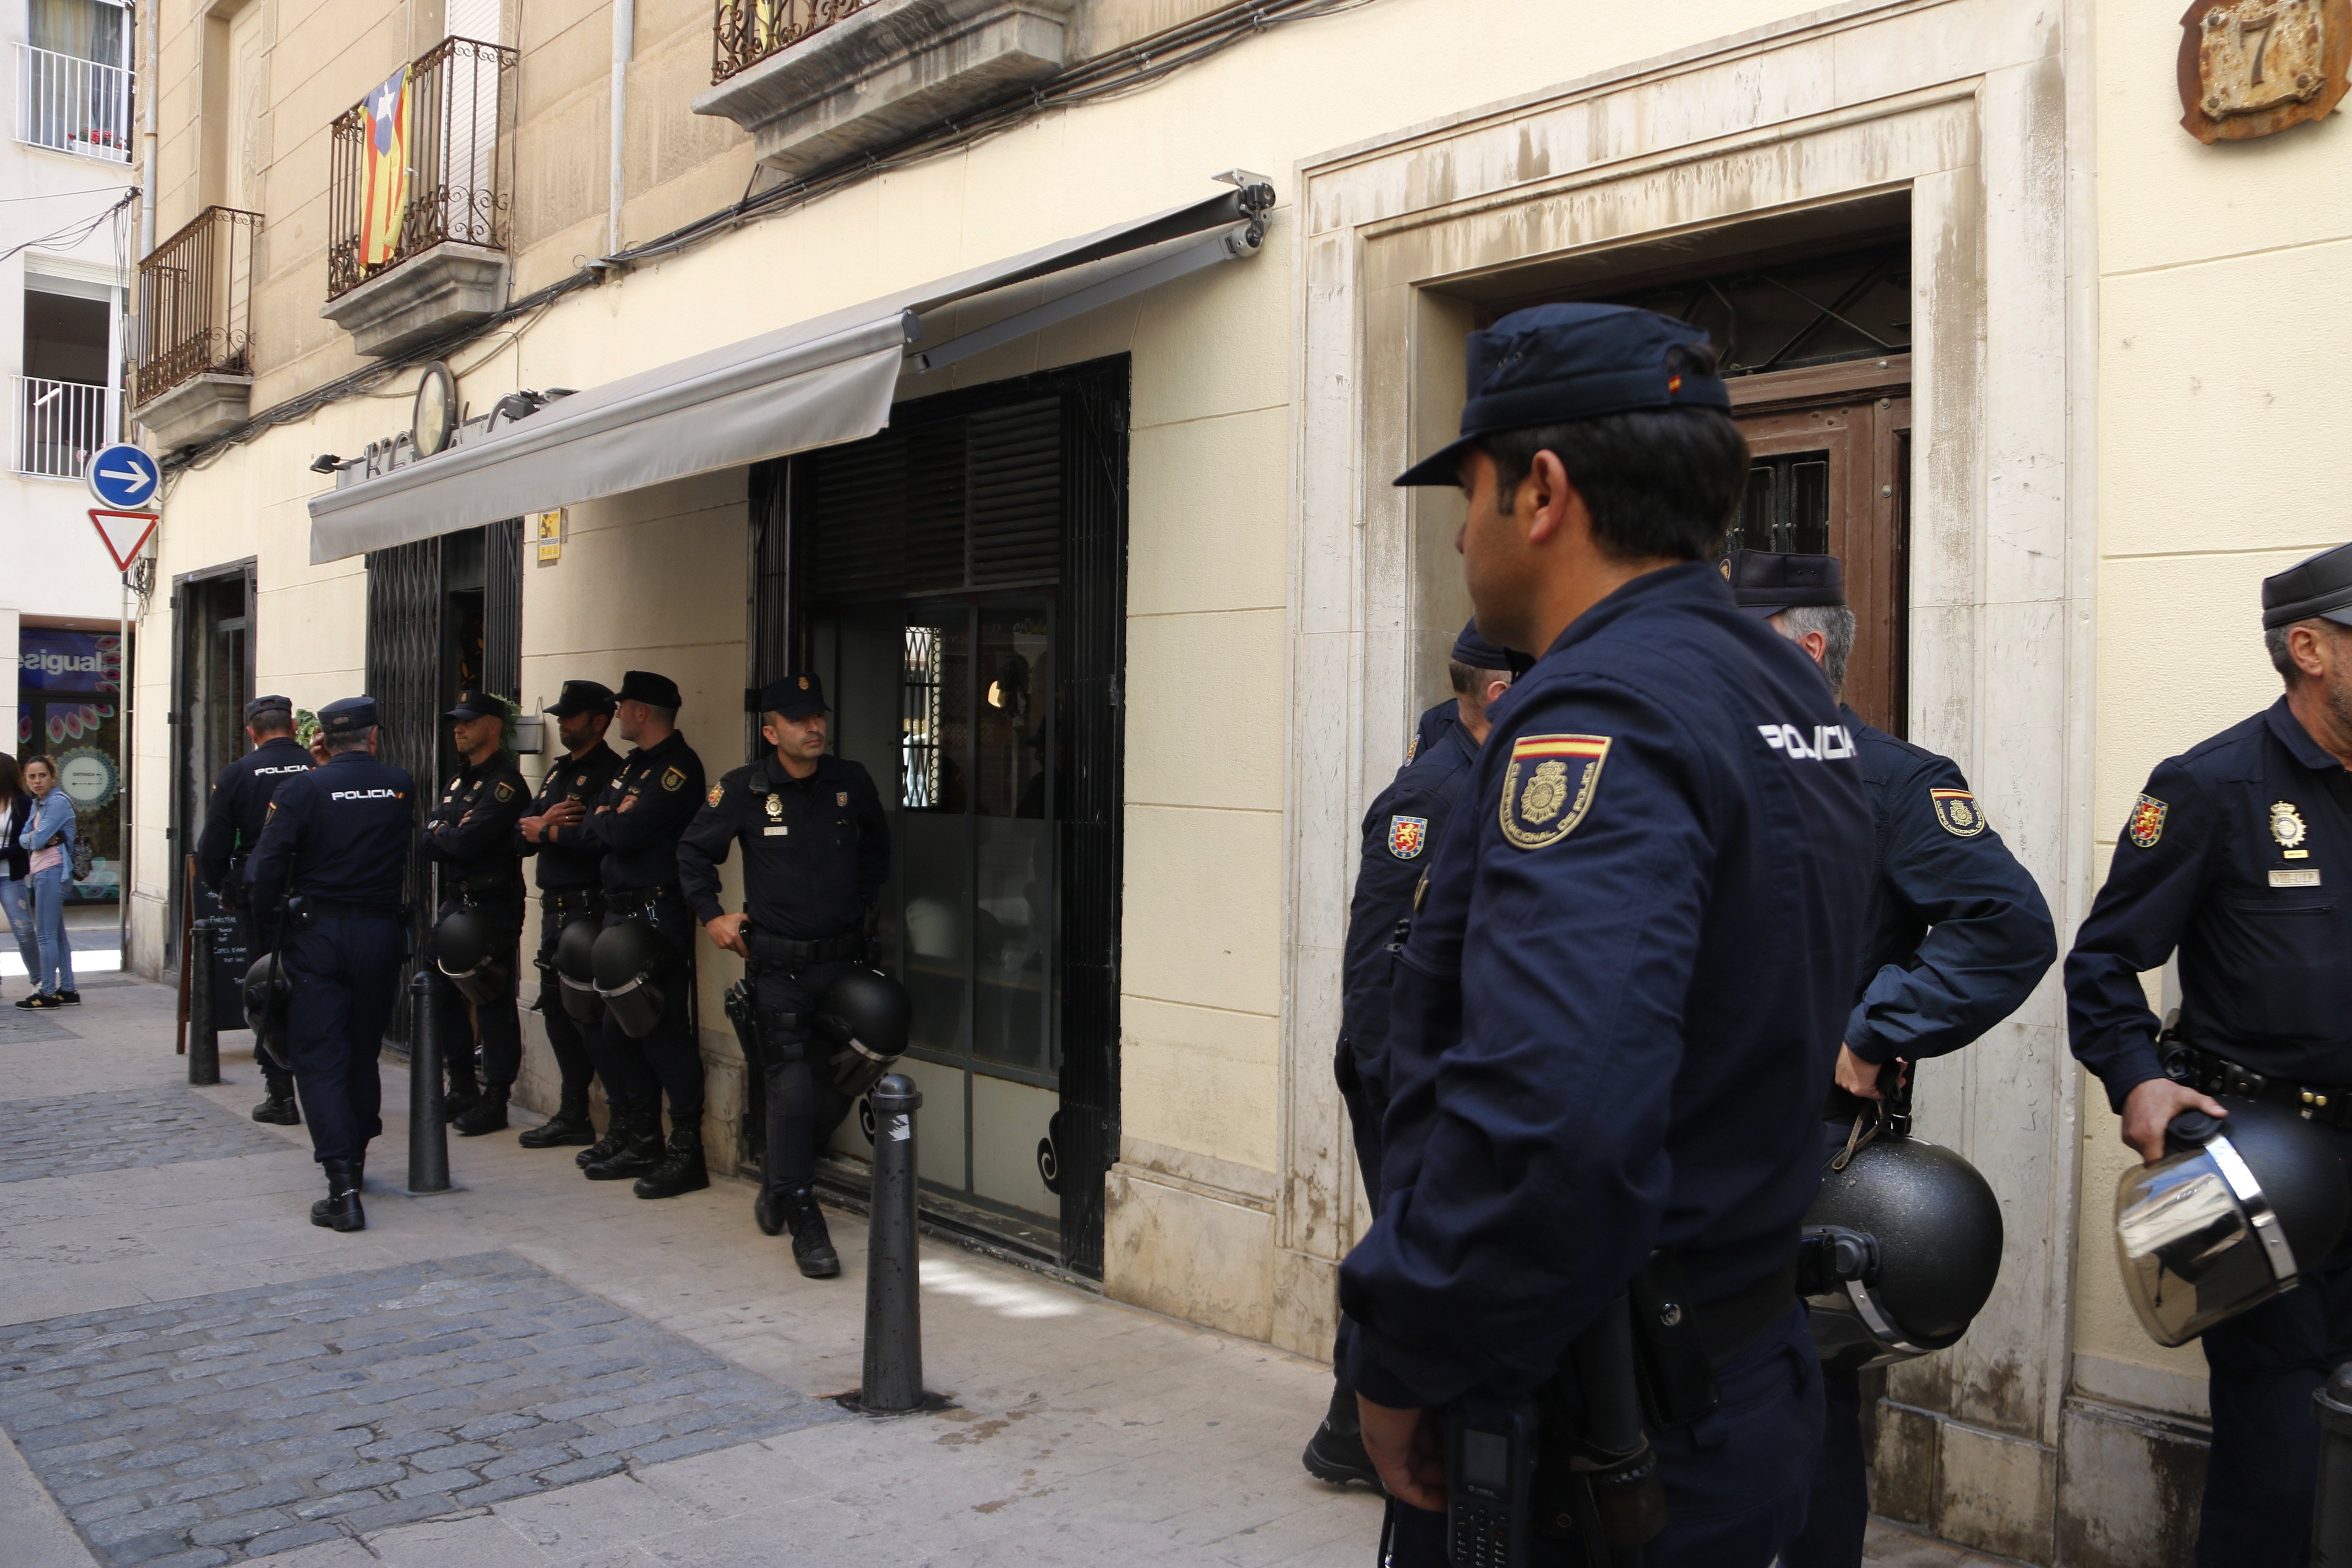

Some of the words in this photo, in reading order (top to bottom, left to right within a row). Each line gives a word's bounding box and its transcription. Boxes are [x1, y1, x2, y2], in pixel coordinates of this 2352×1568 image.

[2239, 13, 2278, 88] 7
[254, 765, 309, 776] POLICIA
[331, 788, 396, 801] POLICIA
[1505, 819, 1559, 842] NACIONAL
[1557, 811, 1578, 831] DE
